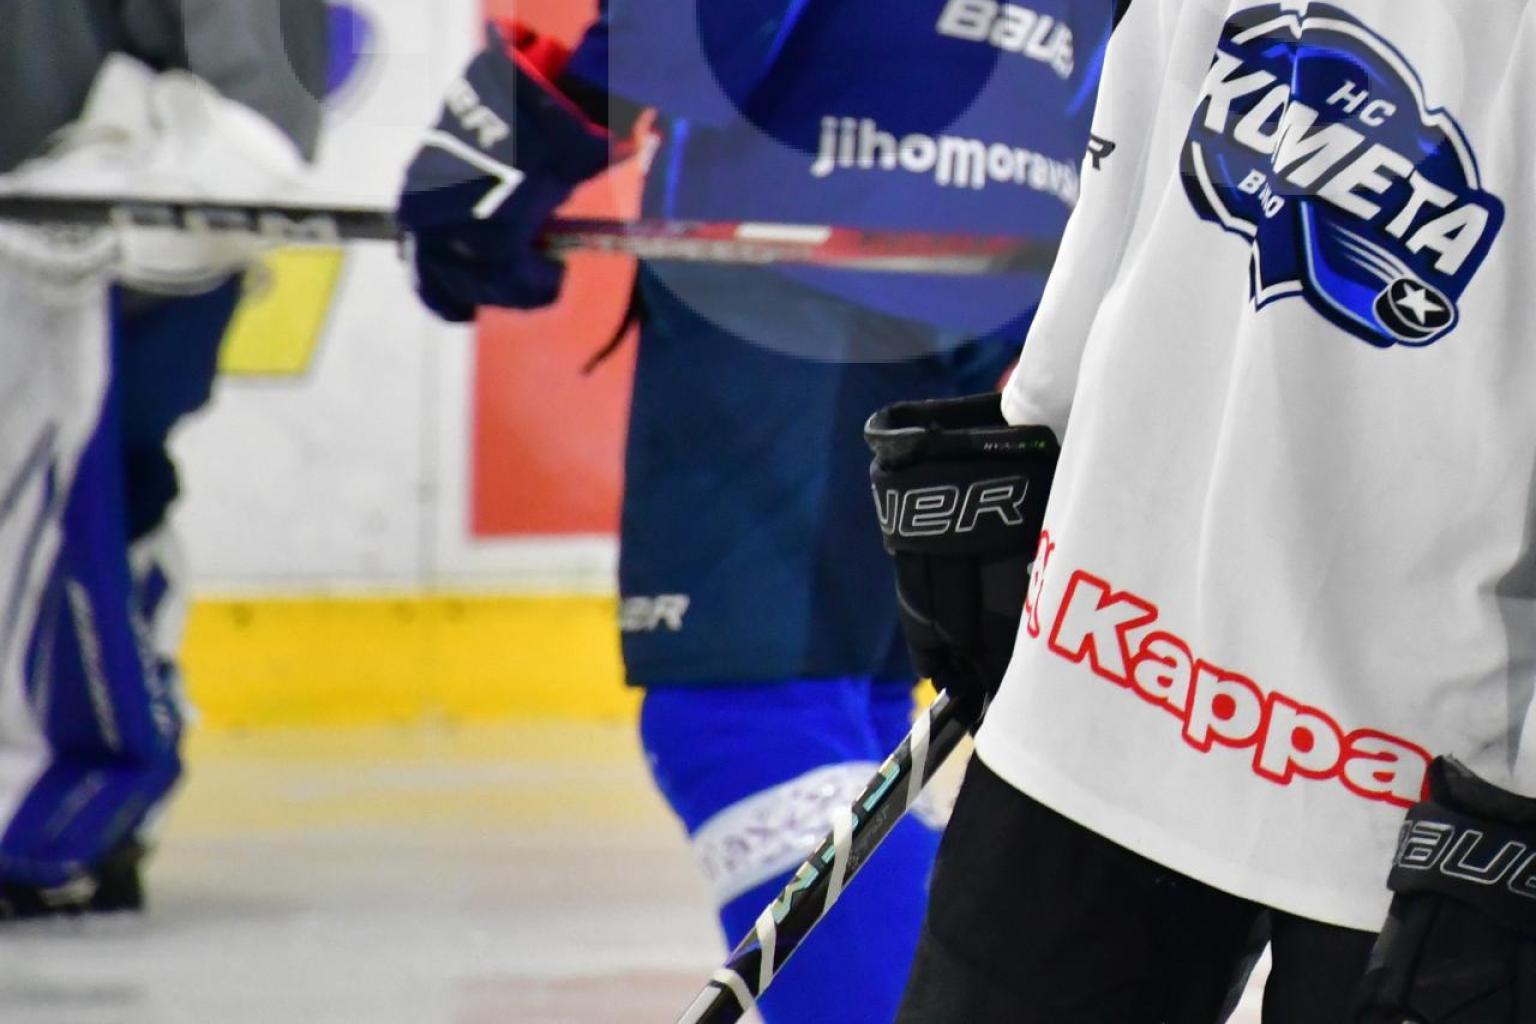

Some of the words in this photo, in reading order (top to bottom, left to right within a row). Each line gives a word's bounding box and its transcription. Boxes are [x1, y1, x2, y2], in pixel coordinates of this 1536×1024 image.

[1197, 51, 1490, 277] KOMETA
[1326, 80, 1398, 127] HC
[1047, 569, 1434, 810] Kappa
